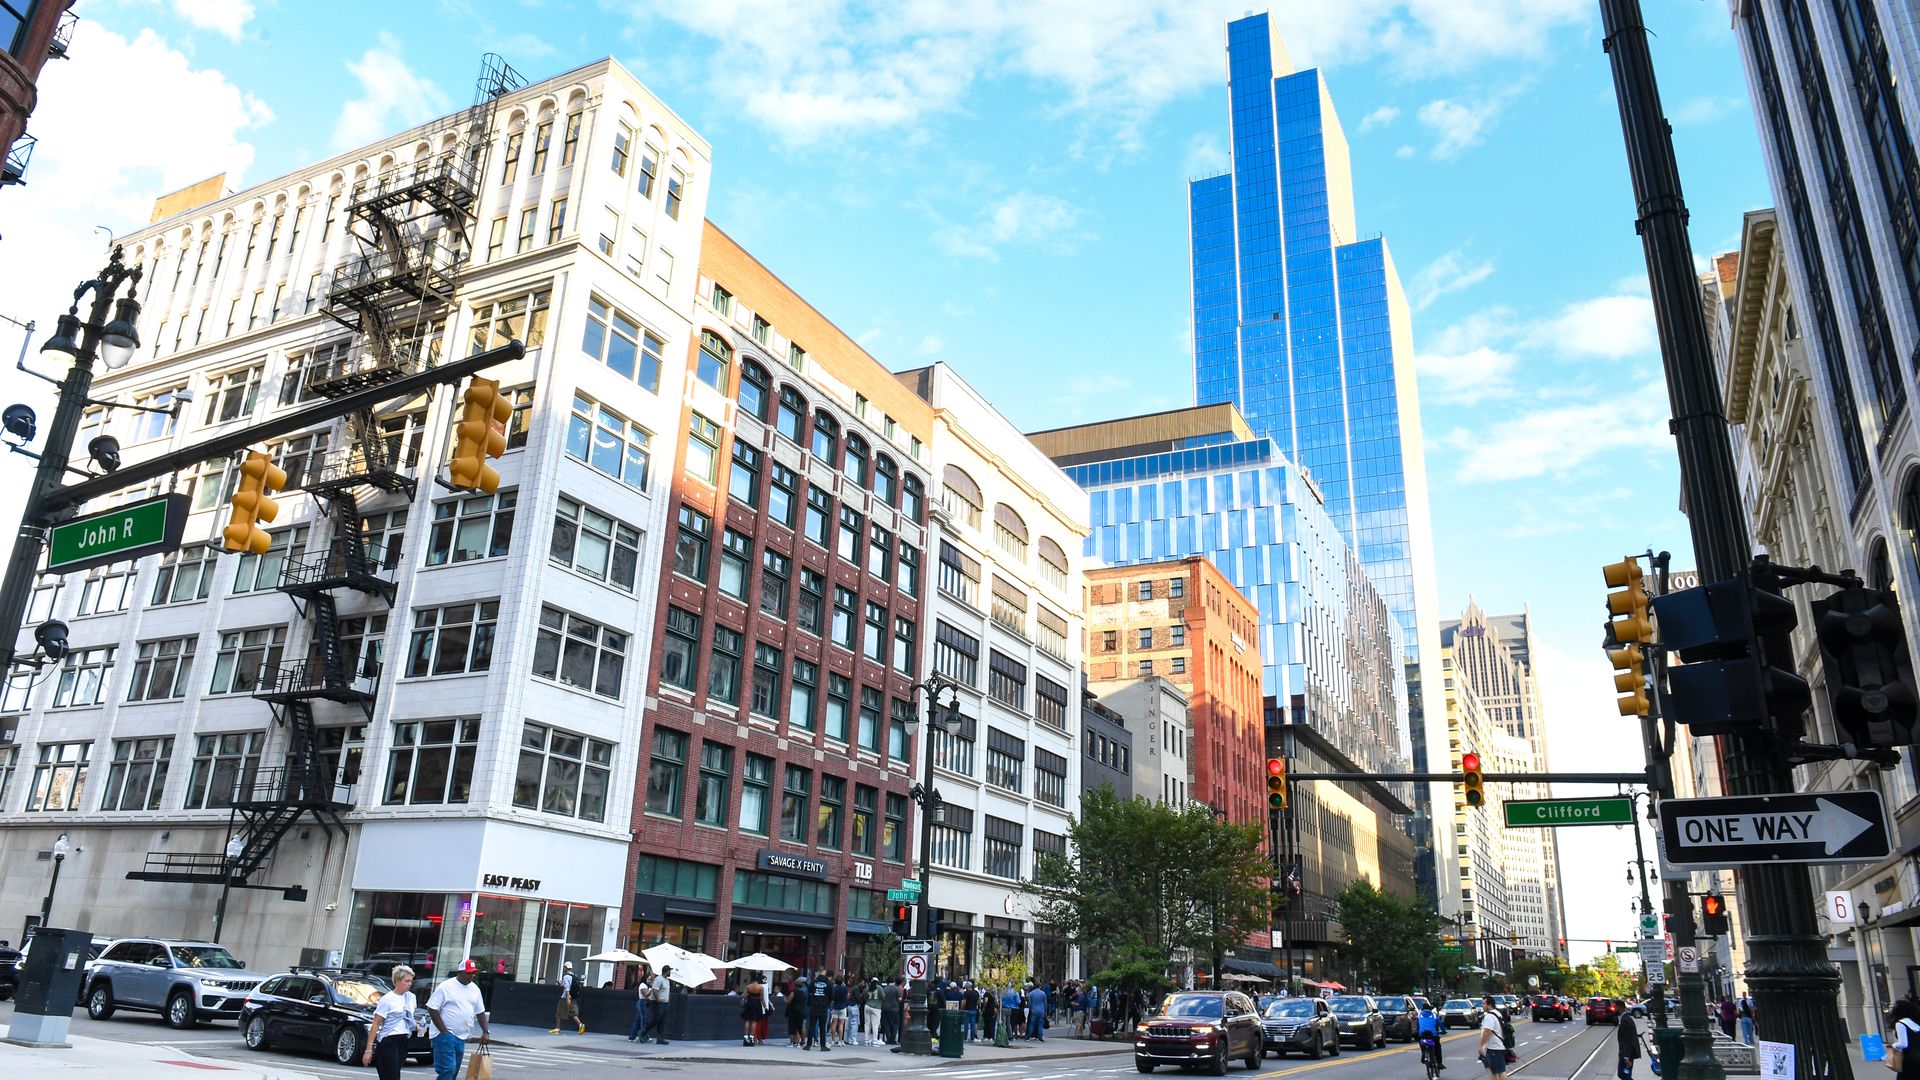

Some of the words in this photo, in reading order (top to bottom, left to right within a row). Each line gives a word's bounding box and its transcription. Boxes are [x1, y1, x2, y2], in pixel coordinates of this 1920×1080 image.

[78, 525, 116, 549] John
[123, 517, 133, 538] R
[1668, 575, 1699, 589] 100
[1148, 683, 1156, 756] SINGER
[1536, 805, 1600, 818] Clifford
[1685, 817, 1744, 844] ONE
[1752, 814, 1813, 841] WAY
[769, 855, 795, 869] SAVAGE
[796, 860, 802, 869] X
[803, 861, 824, 873] FENTY
[854, 861, 873, 879] TLB
[483, 873, 509, 886] EASY
[510, 877, 541, 890] PEASY
[892, 892, 908, 900] John
[1648, 973, 1664, 981] 25
